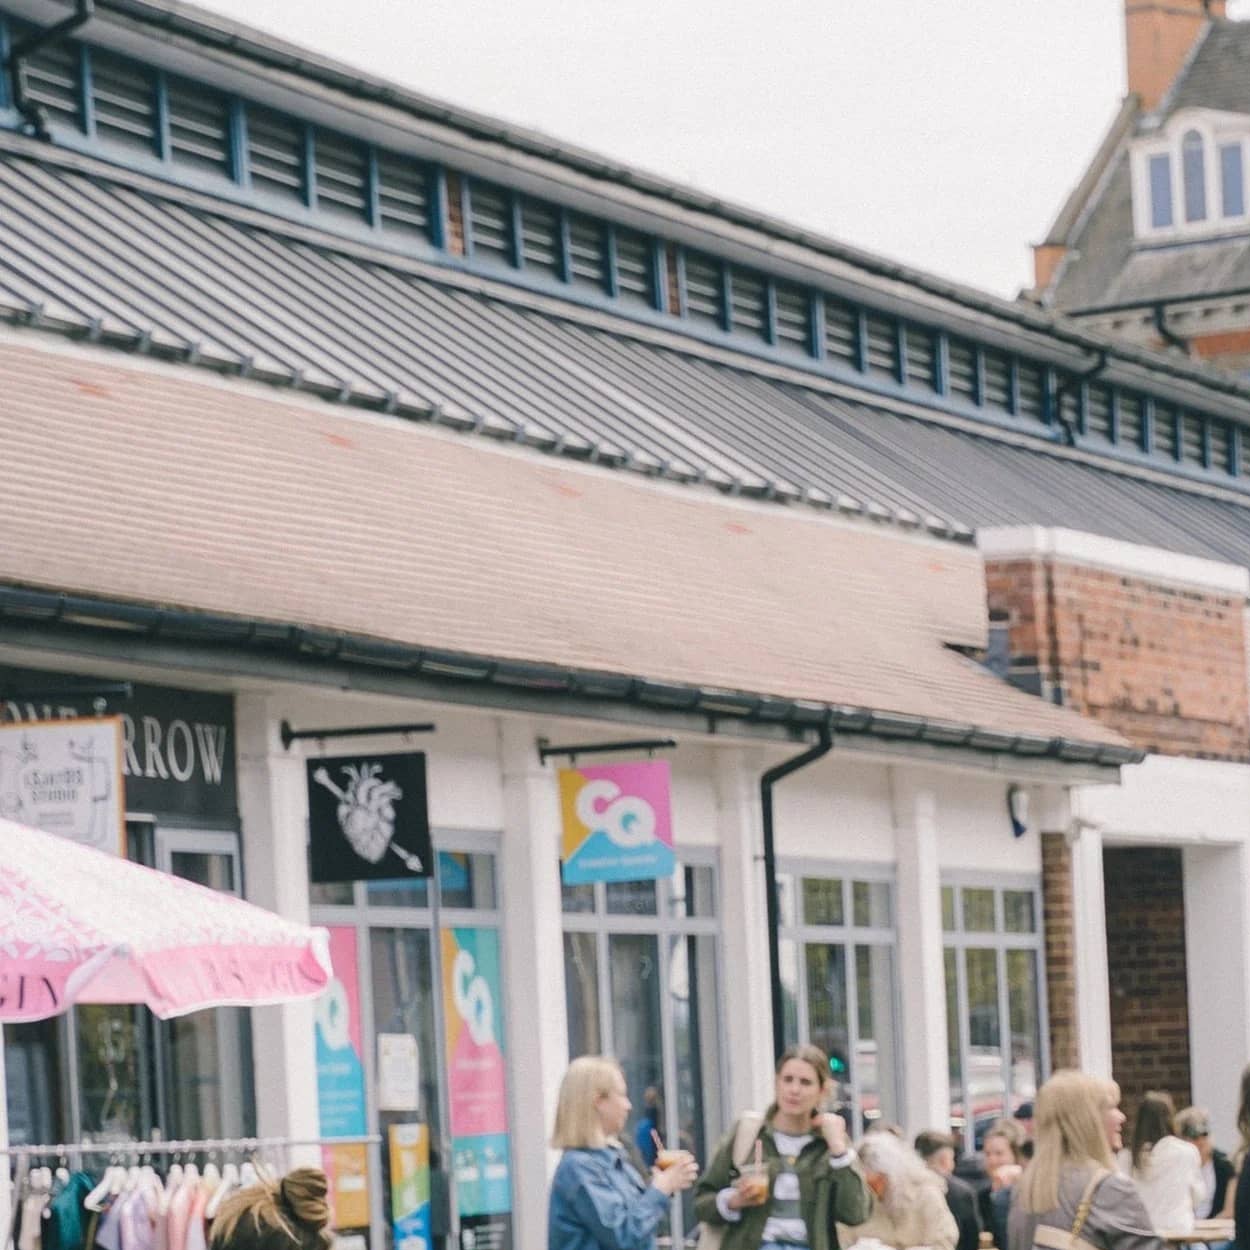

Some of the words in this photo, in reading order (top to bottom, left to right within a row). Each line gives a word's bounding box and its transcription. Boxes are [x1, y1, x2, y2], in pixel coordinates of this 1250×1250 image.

[120, 713, 227, 785] RROW
[576, 779, 656, 848] CQ
[0, 975, 57, 1008] IN
[317, 973, 350, 1049] Q
